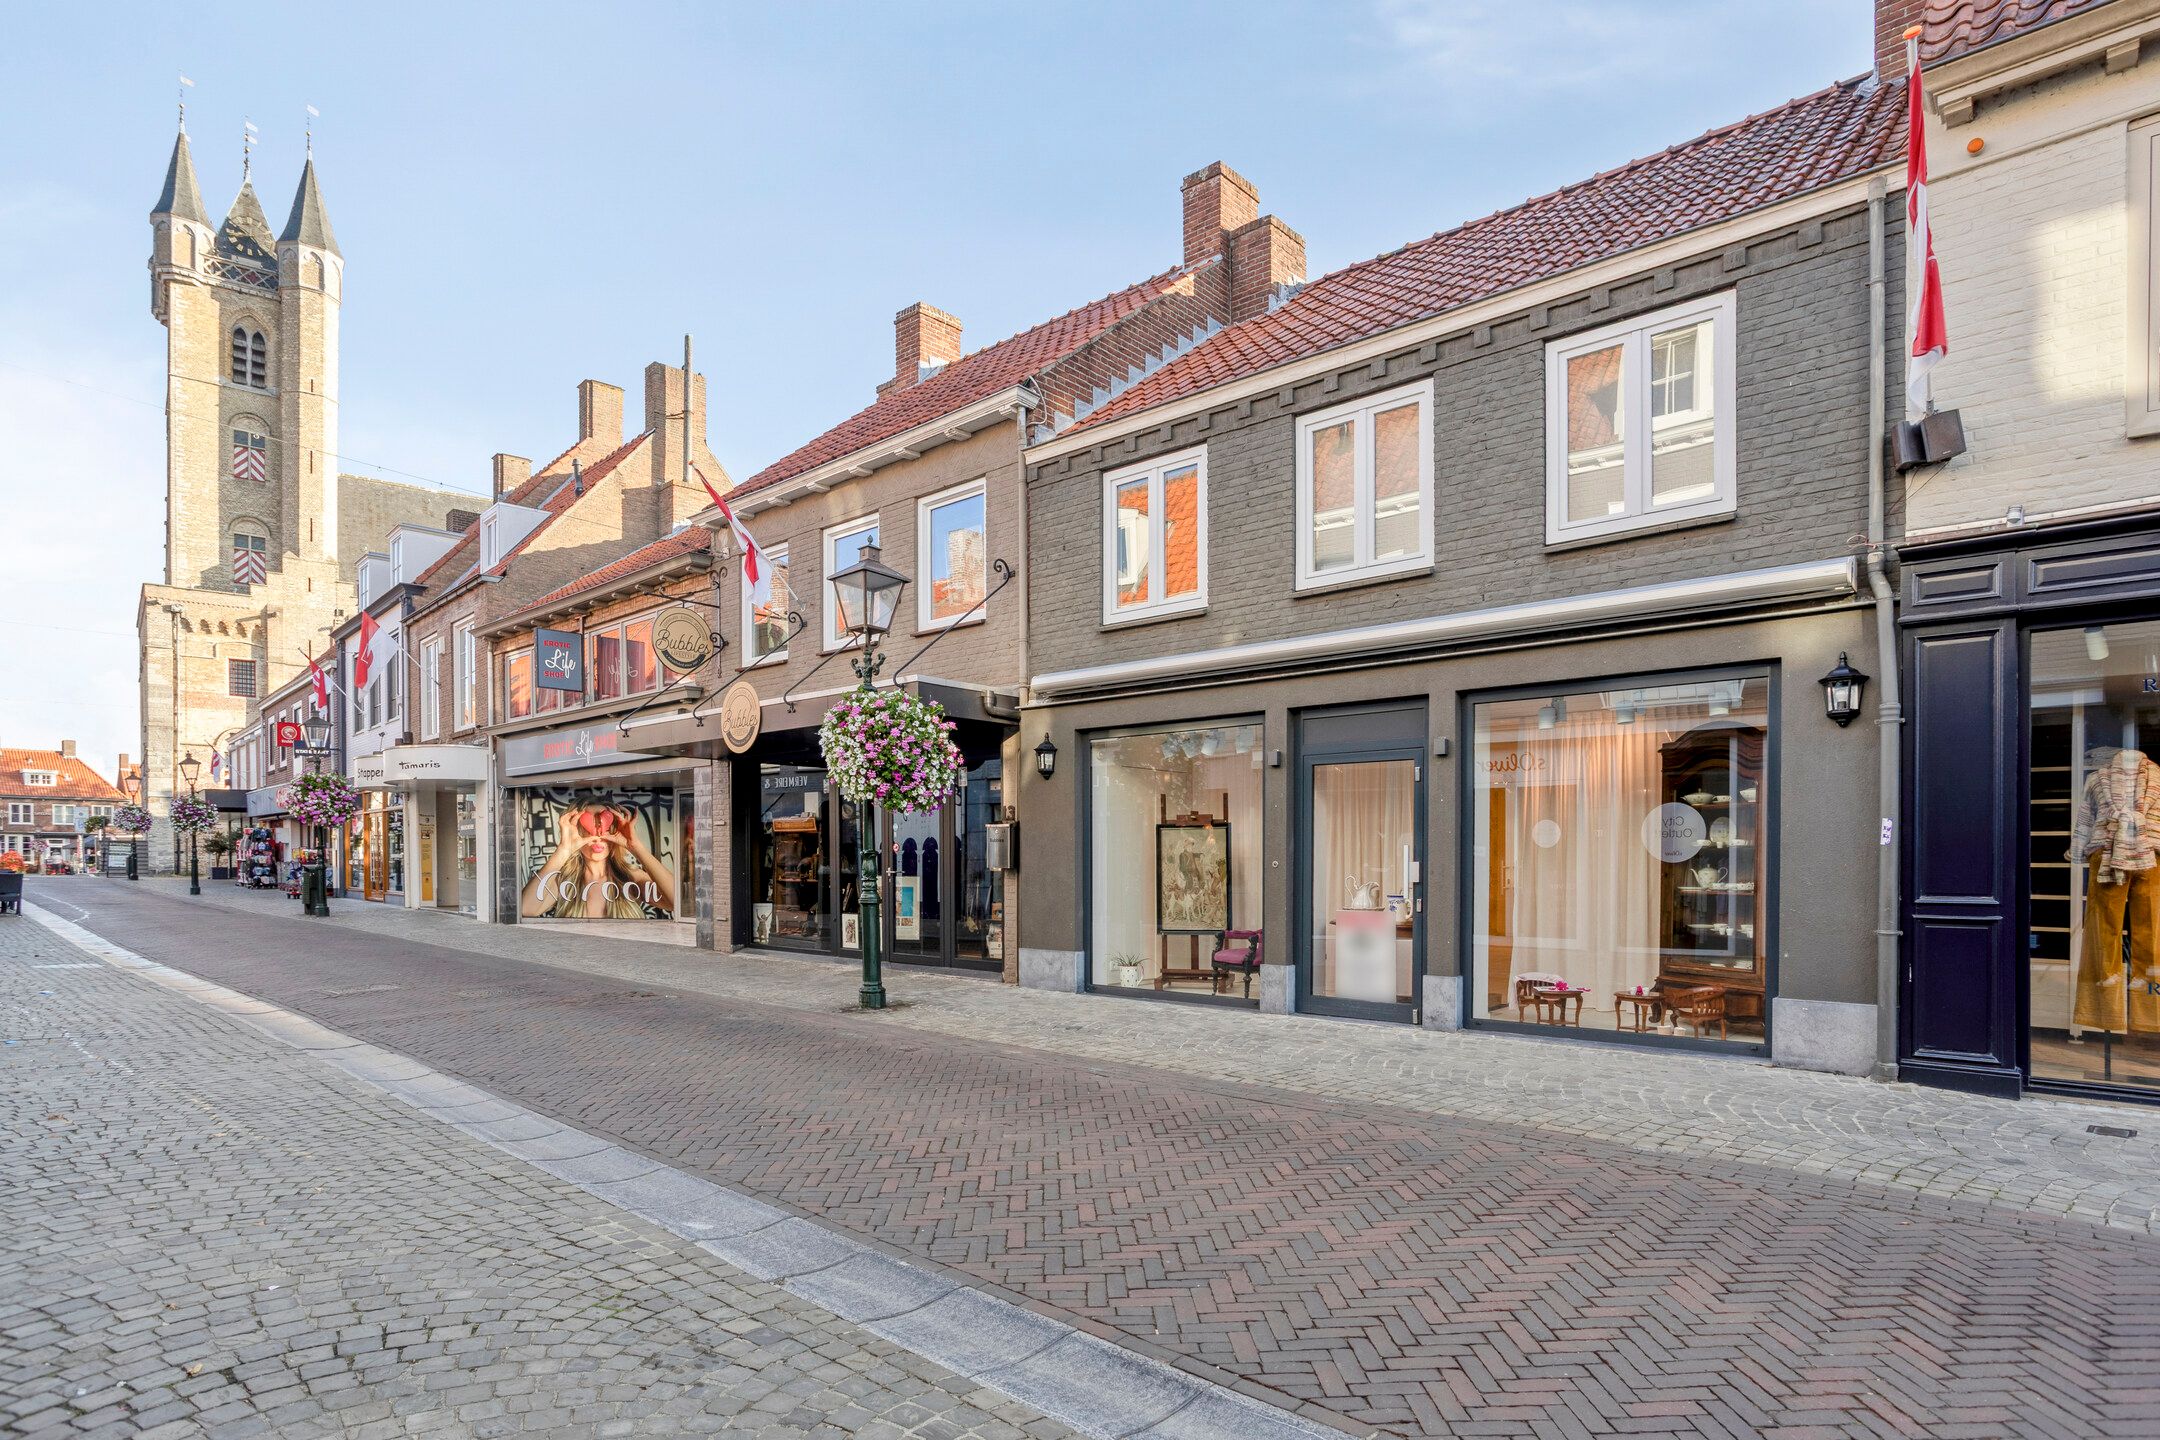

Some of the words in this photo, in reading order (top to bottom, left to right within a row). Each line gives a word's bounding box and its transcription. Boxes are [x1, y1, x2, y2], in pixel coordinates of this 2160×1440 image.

[543, 640, 571, 649] EROTIC
[655, 629, 711, 655] Bubbles
[543, 671, 565, 679] SHOP
[544, 649, 576, 679] Life
[723, 709, 758, 733] Bubbles
[543, 739, 575, 760] EROTIC
[575, 730, 594, 765] Life
[399, 760, 441, 770] Tamaris
